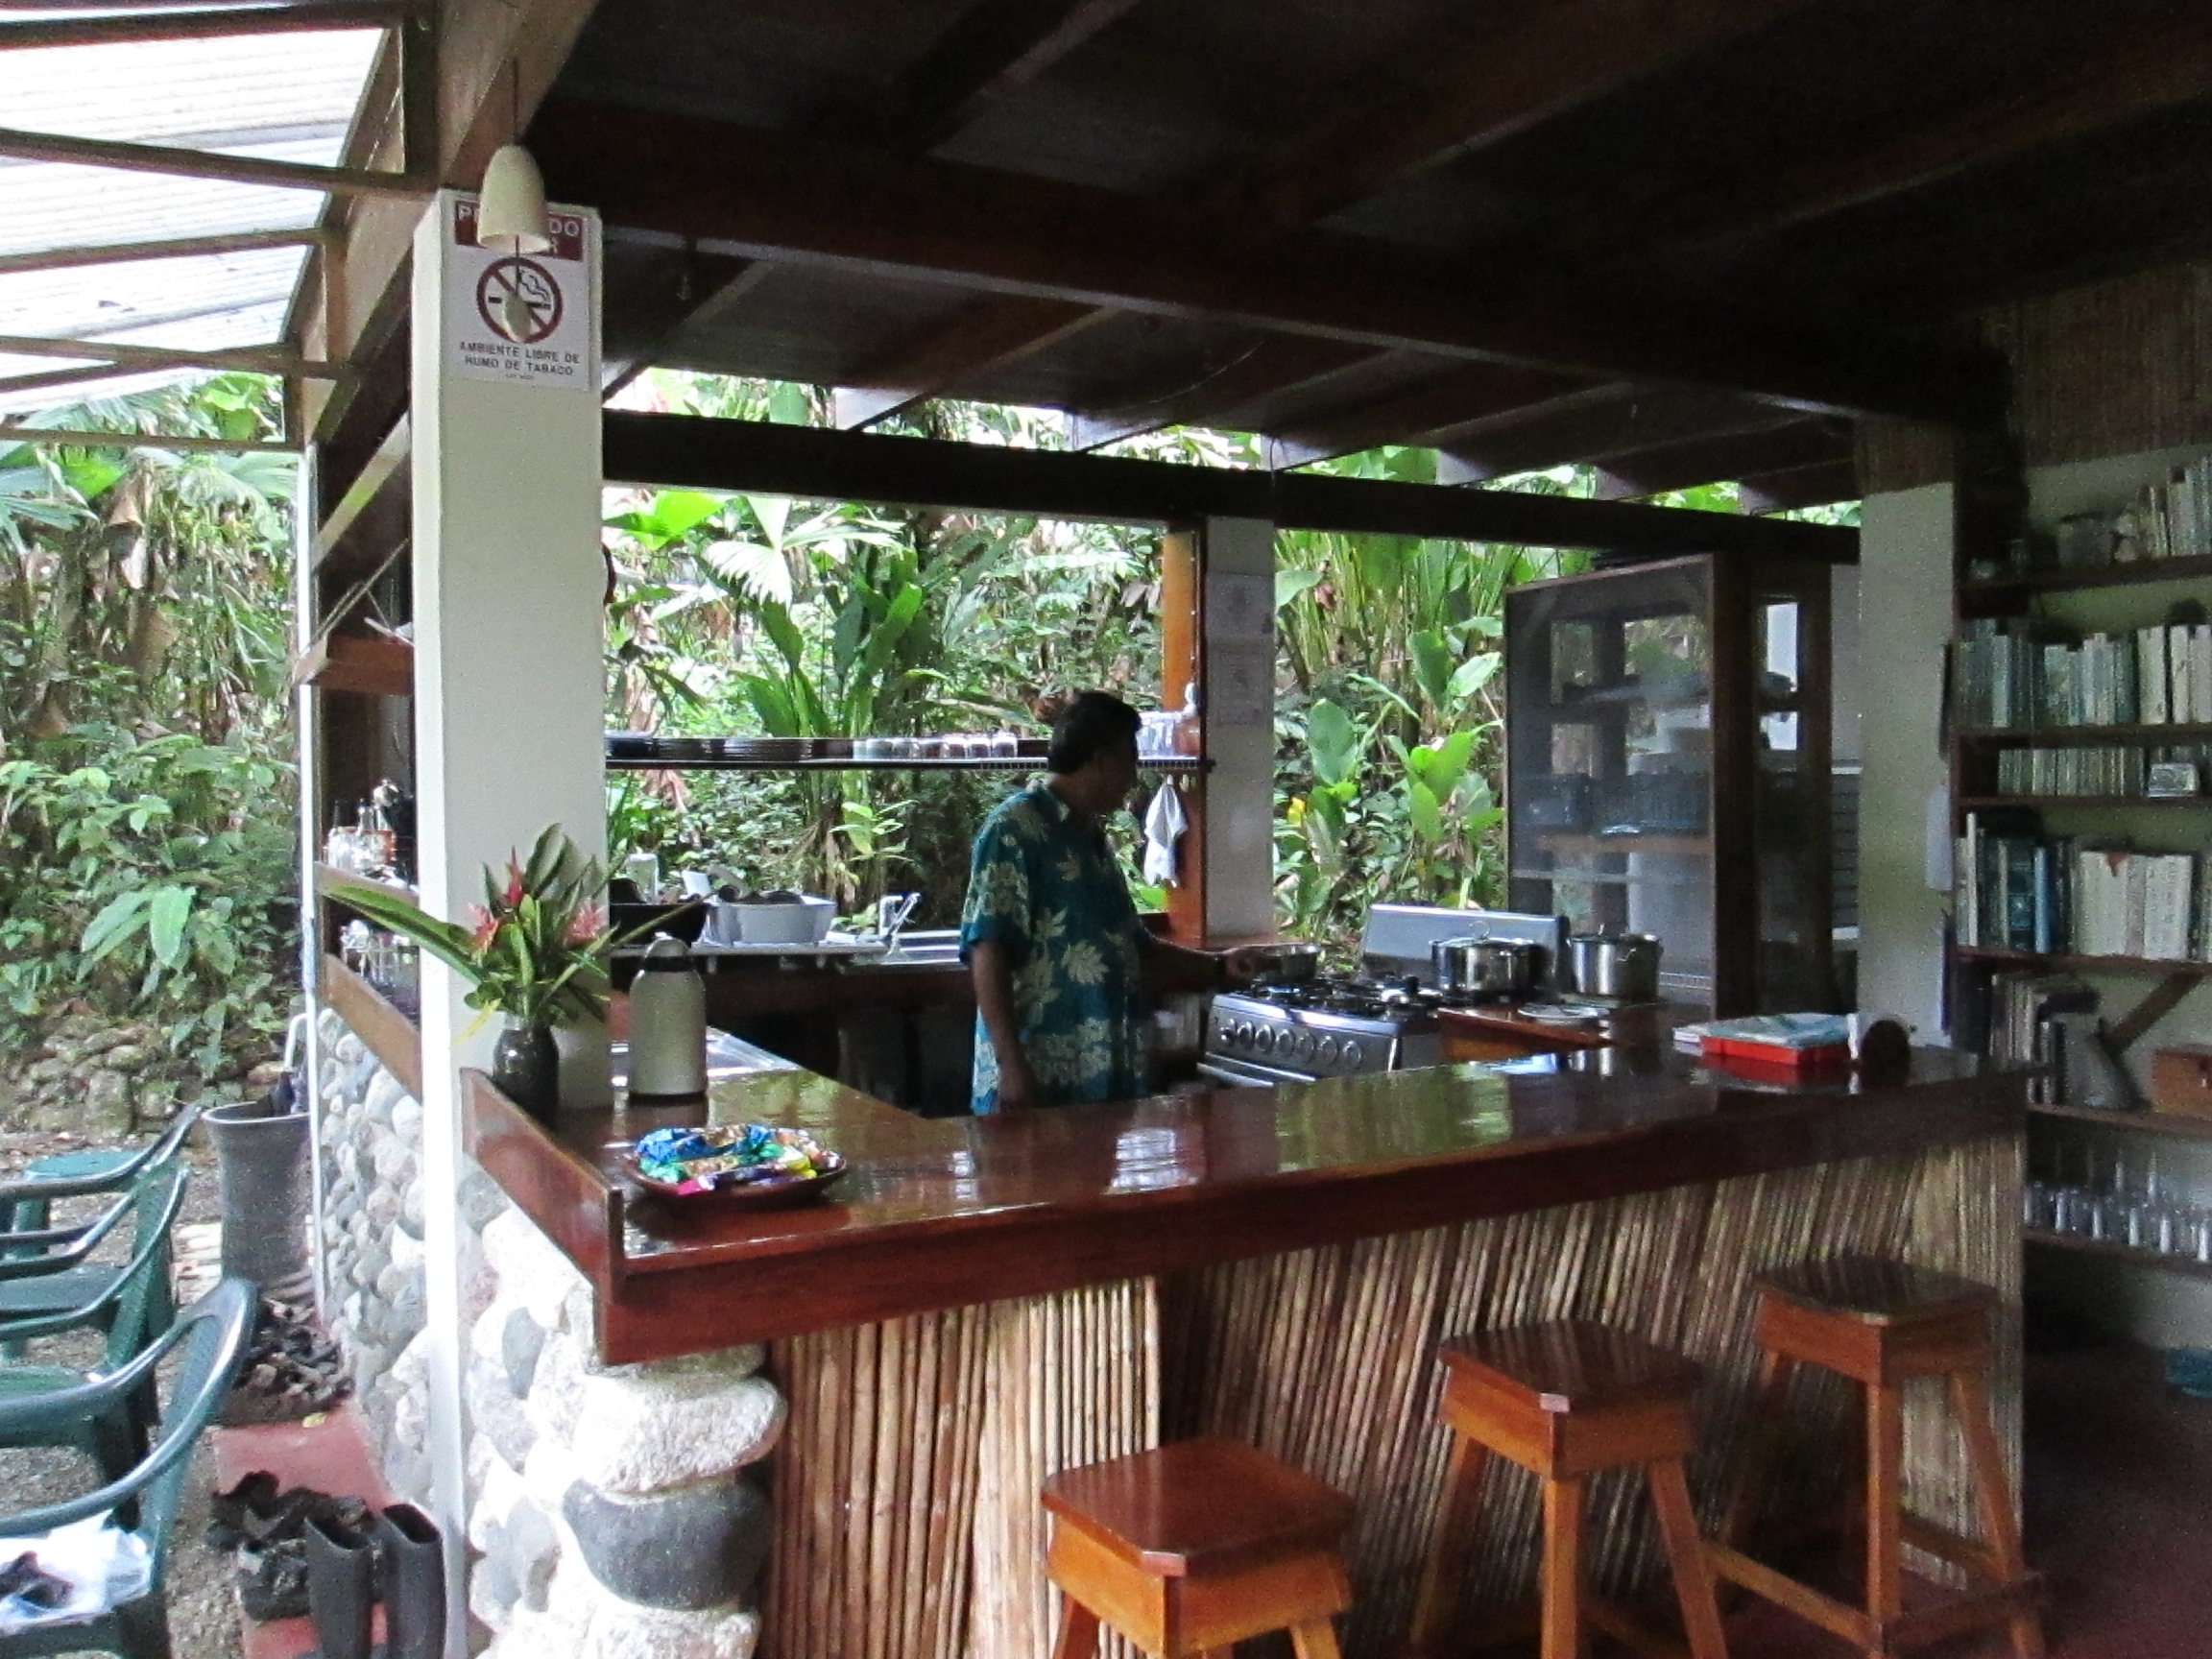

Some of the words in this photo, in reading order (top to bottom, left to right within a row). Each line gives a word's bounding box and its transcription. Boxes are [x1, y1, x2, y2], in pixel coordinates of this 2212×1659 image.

[460, 341, 519, 357] AMBIENTE
[525, 349, 559, 362] LIBRE
[565, 351, 580, 364] DE
[465, 355, 499, 369] HUMO
[505, 359, 520, 371] DE
[527, 362, 573, 375] TABACO
